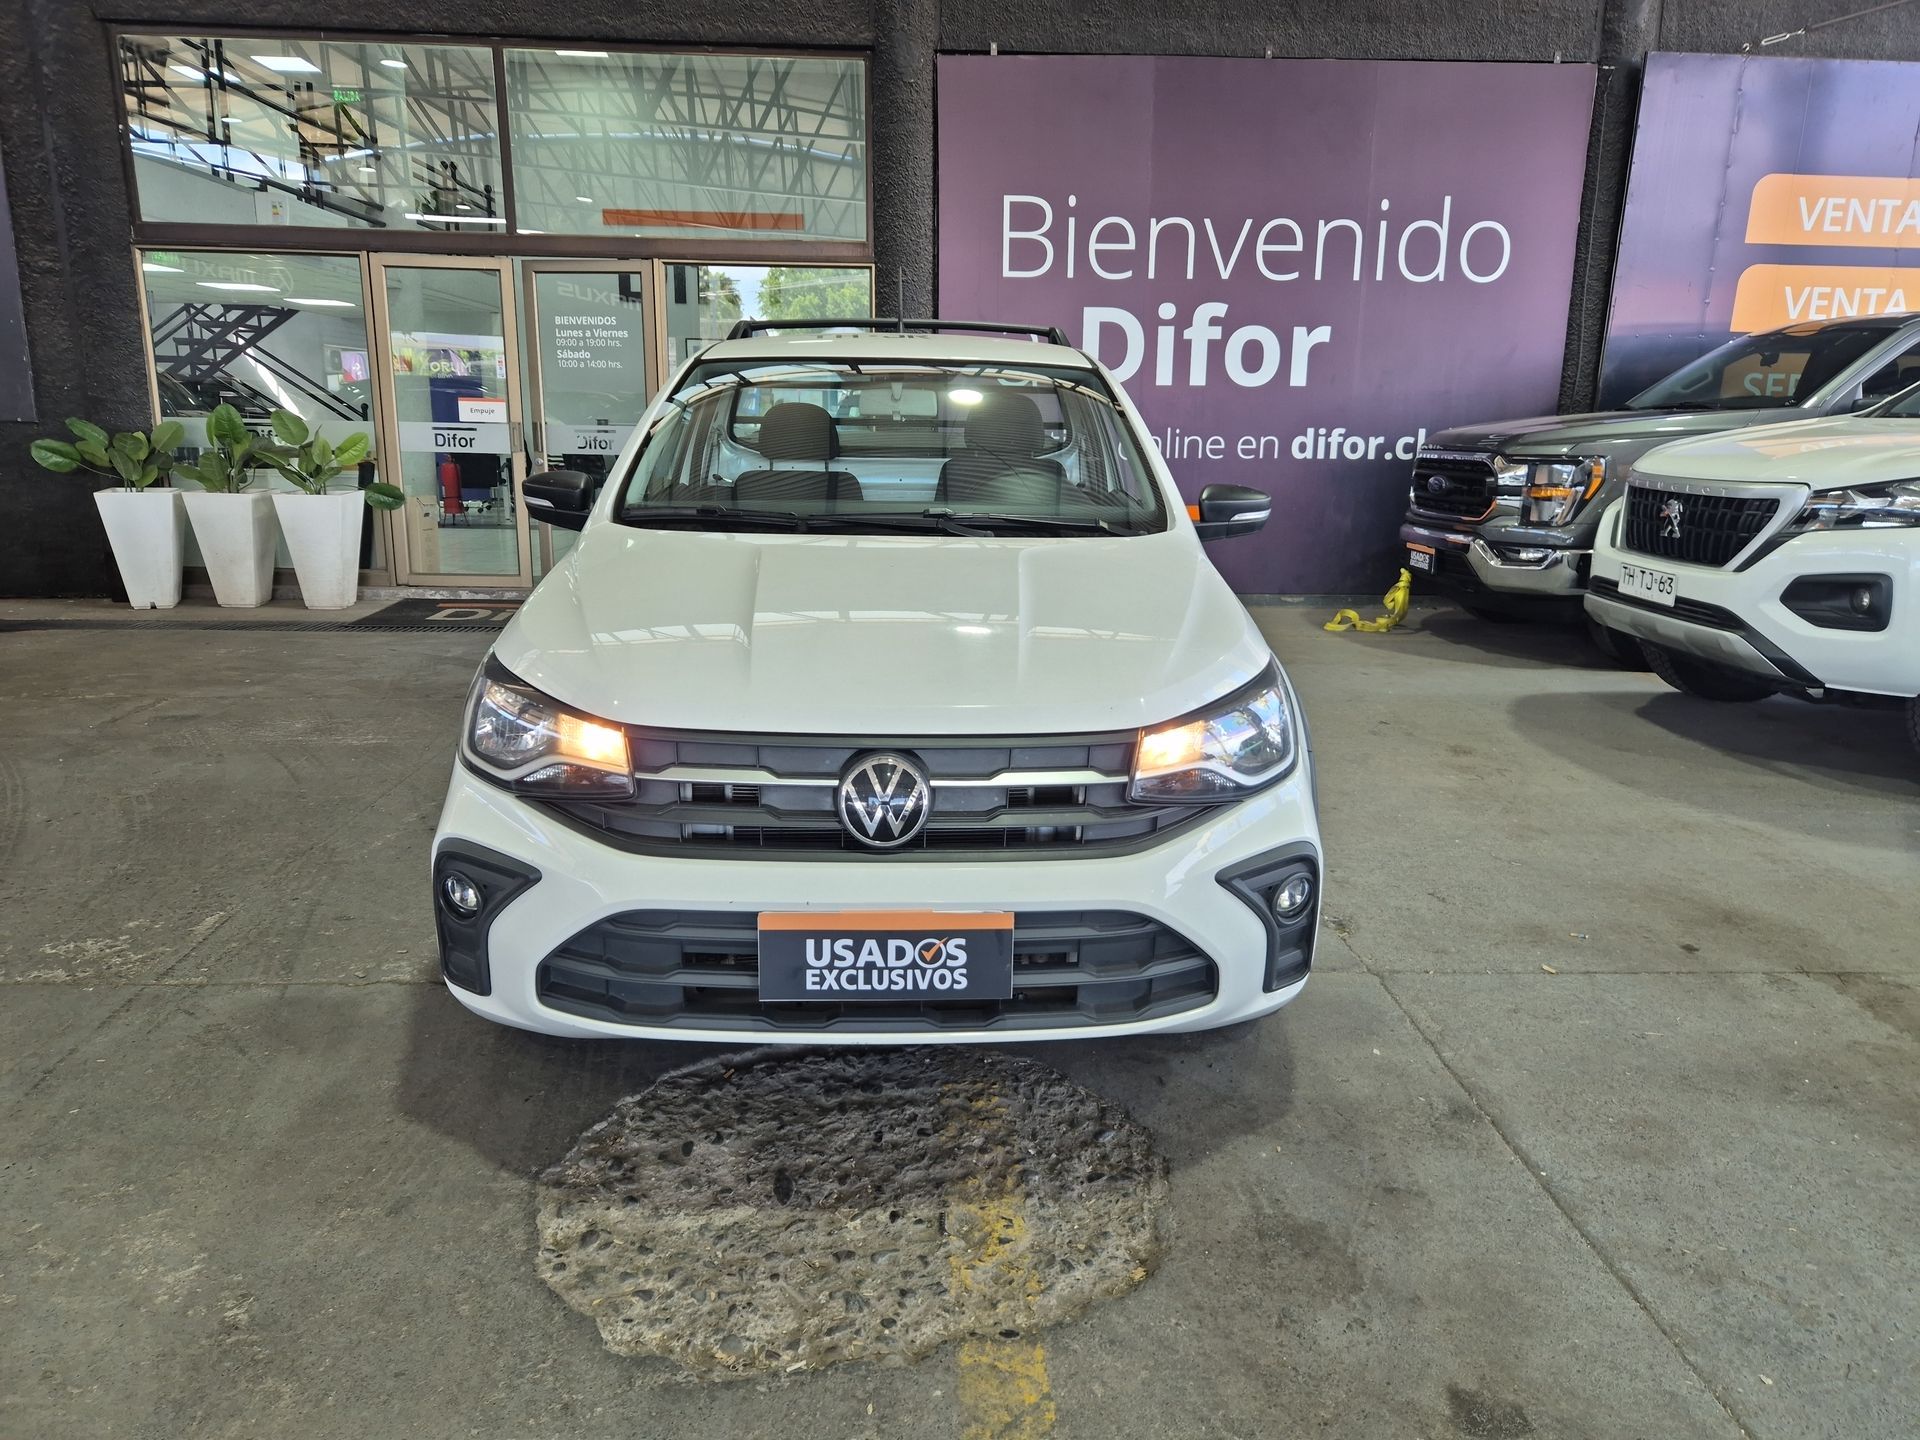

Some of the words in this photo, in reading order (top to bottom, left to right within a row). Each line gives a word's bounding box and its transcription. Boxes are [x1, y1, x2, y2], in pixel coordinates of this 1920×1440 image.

[1799, 197, 1920, 234] VENTA
[1001, 194, 1512, 284] Bienvenido
[1784, 286, 1907, 321] VENTA
[555, 316, 617, 325] BIENVENIDOS
[555, 328, 583, 337] Lunes
[593, 328, 629, 338] Viernes
[555, 339, 577, 347] 09:00
[586, 339, 606, 347] 19:00
[607, 339, 622, 347] hrs.
[1082, 302, 1332, 387] Difor
[557, 349, 591, 359] Sábado
[558, 360, 578, 368] 10:00
[586, 360, 607, 368] 14:00
[608, 360, 623, 369] hrs.
[470, 407, 496, 416] Empuje
[434, 433, 475, 448] Difor
[576, 435, 615, 450] Difor
[1236, 435, 1279, 459] en
[805, 937, 968, 969] USADOS
[805, 968, 968, 990] EXCLUSIVOS
